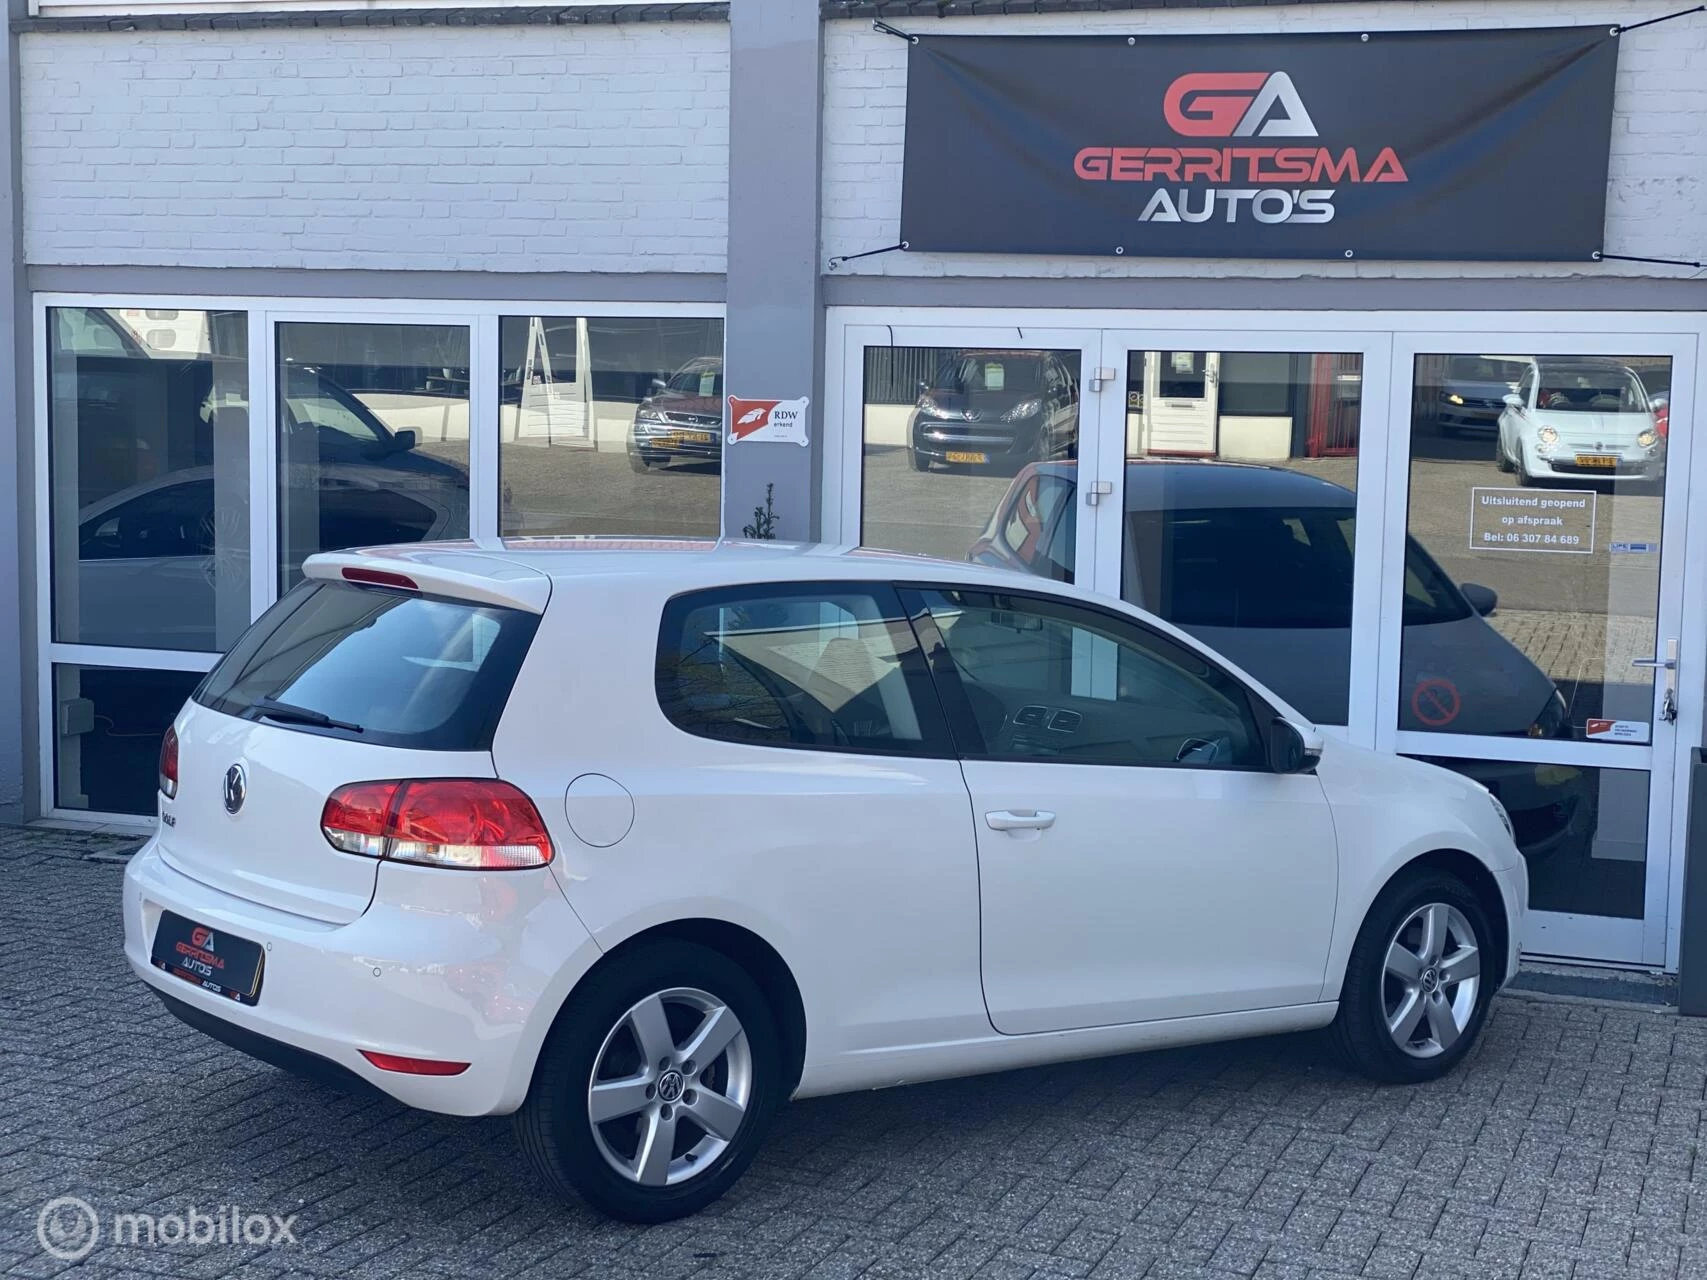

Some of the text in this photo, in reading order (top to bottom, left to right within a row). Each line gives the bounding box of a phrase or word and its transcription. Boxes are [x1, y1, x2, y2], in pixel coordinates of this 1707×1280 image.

[1163, 71, 1319, 137] GA
[1074, 147, 1409, 182] GERRITSMA
[1138, 188, 1336, 223] AUTO'S
[774, 411, 798, 420] RDW
[1481, 495, 1586, 509] Uitsluitend geopend
[1502, 515, 1563, 527] op afspraak
[1484, 532, 1580, 545] Bel: 06 307 84 689
